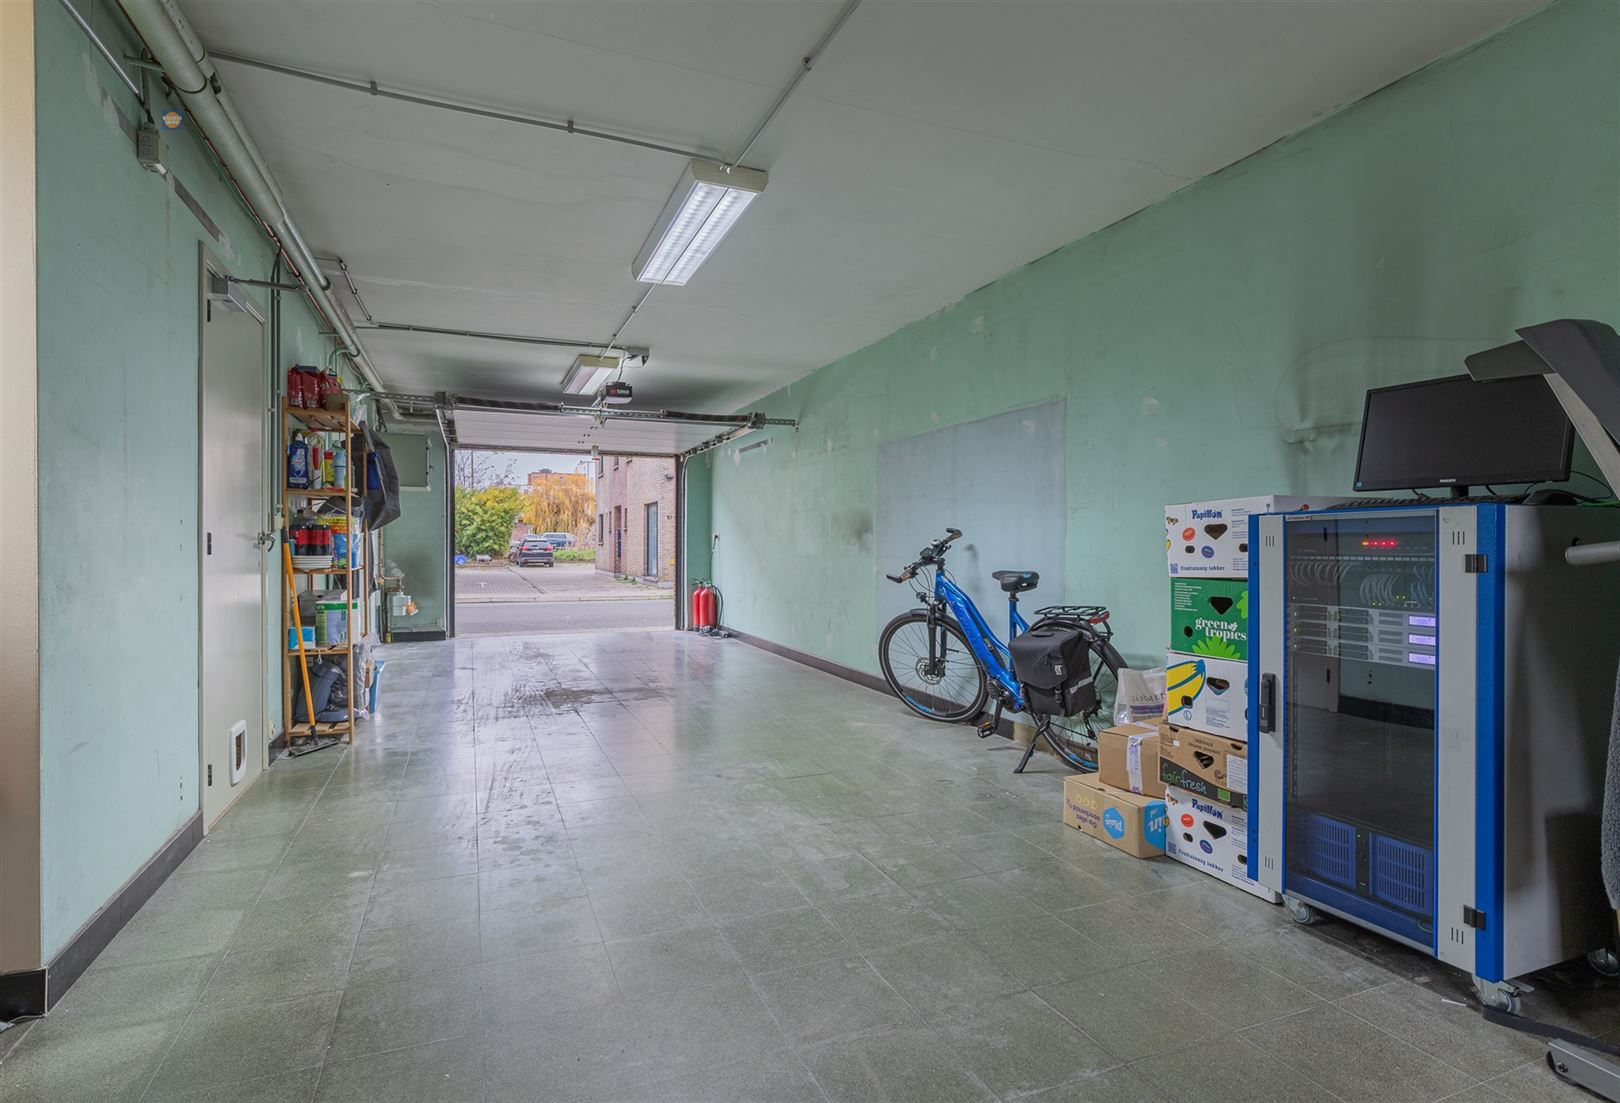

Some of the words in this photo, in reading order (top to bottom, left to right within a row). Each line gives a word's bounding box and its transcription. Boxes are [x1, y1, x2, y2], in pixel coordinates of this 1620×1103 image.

[1191, 509, 1222, 520] Papillon
[1195, 617, 1227, 630] green
[1205, 627, 1247, 641] tropics
[1191, 798, 1223, 819] Papillon
[1206, 860, 1224, 872] lekker
